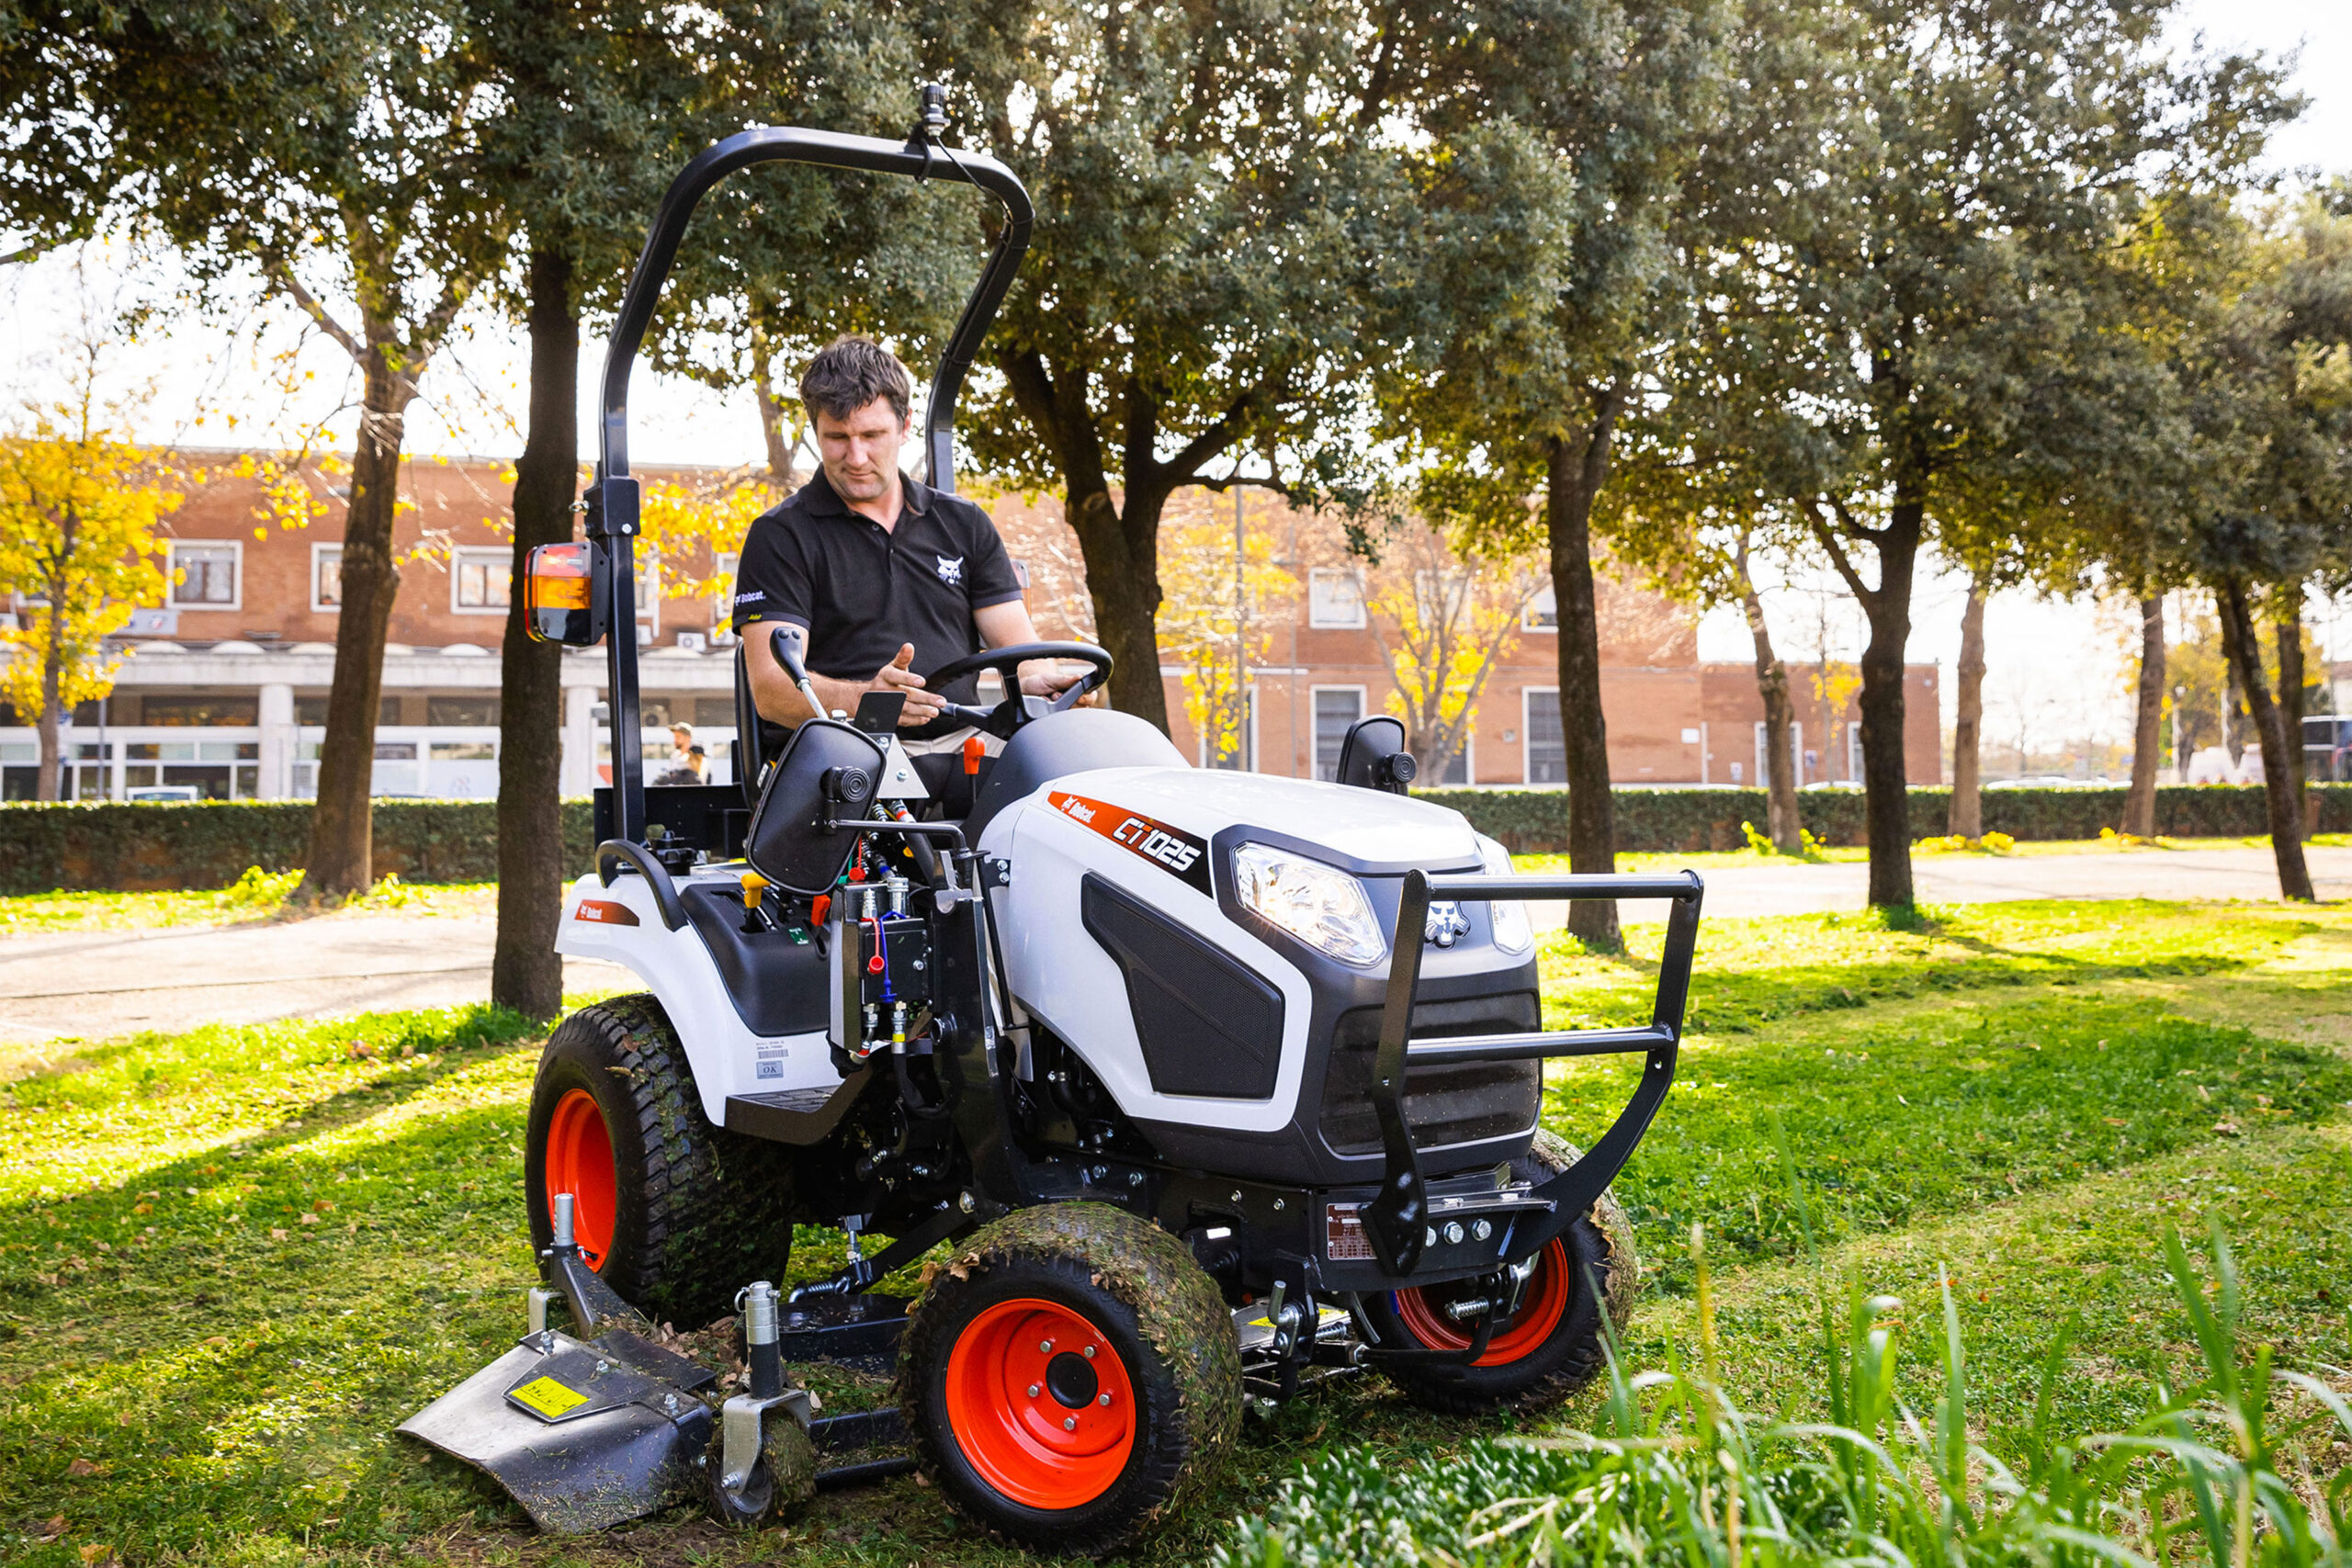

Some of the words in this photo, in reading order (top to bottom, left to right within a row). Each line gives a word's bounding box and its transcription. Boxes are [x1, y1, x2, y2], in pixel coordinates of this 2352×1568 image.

[1069, 801, 1096, 824] Bobcat
[1113, 817, 1202, 872] CT1025
[763, 1066, 777, 1074] OK
